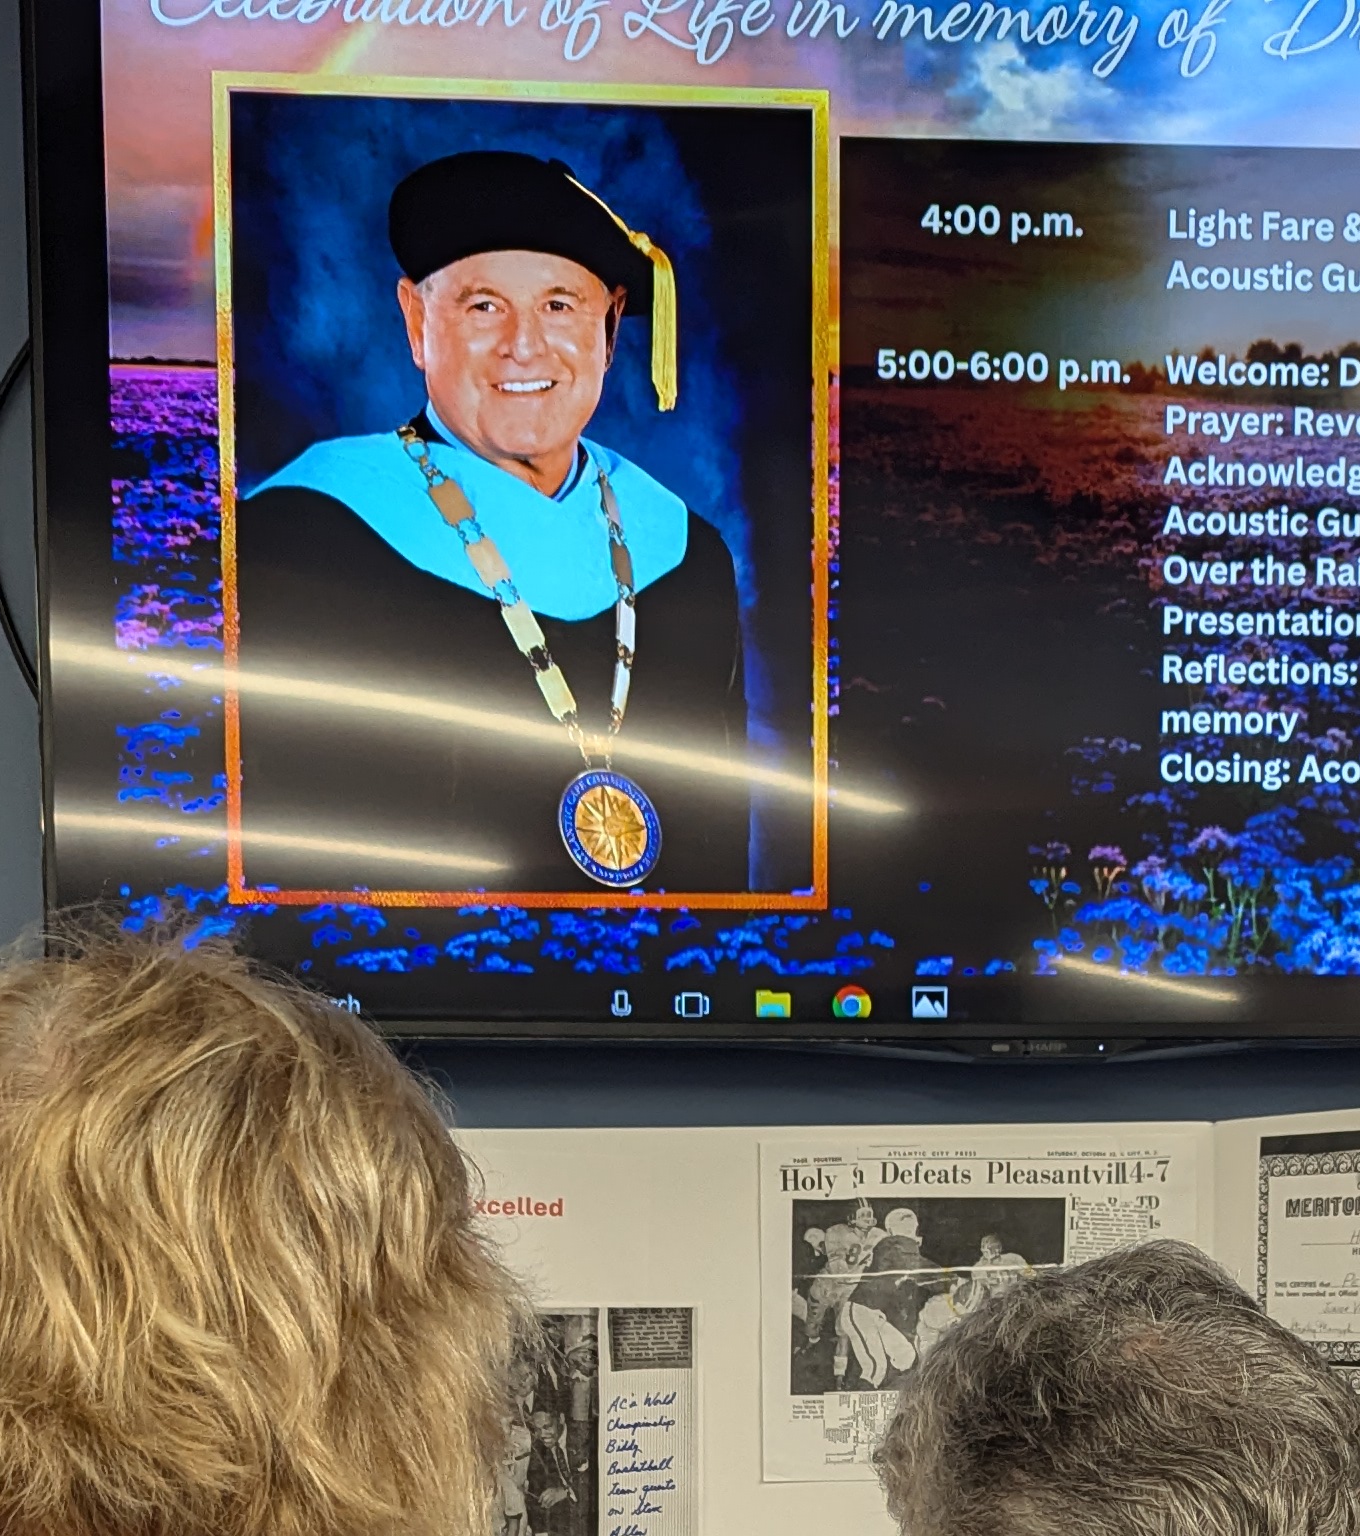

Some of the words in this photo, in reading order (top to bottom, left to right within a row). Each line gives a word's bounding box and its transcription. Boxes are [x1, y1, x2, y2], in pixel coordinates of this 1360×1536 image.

[540, 0, 602, 60] of
[623, 0, 778, 65] Life
[785, 0, 856, 38] in
[871, 0, 1140, 78] memory
[1157, 0, 1226, 78] of
[921, 204, 1001, 236] 4:00
[1010, 212, 1084, 242] p.m.
[1168, 209, 1253, 248] Light
[1262, 212, 1336, 242] Fare
[1165, 259, 1315, 293] Acoustic
[876, 349, 1050, 384] 5:00-6:00
[1058, 357, 1133, 390] p.m.
[1164, 354, 1331, 388] Welcome:
[1165, 404, 1285, 443] Prayer:
[1162, 508, 1308, 539] Acoustic
[1162, 557, 1253, 589] Over
[1253, 556, 1308, 588] the
[1161, 655, 1359, 688] Reflections:
[1160, 710, 1299, 743] memory
[1159, 754, 1293, 792] Closing:
[779, 1167, 838, 1198] Holy
[879, 1161, 972, 1185] Defeats
